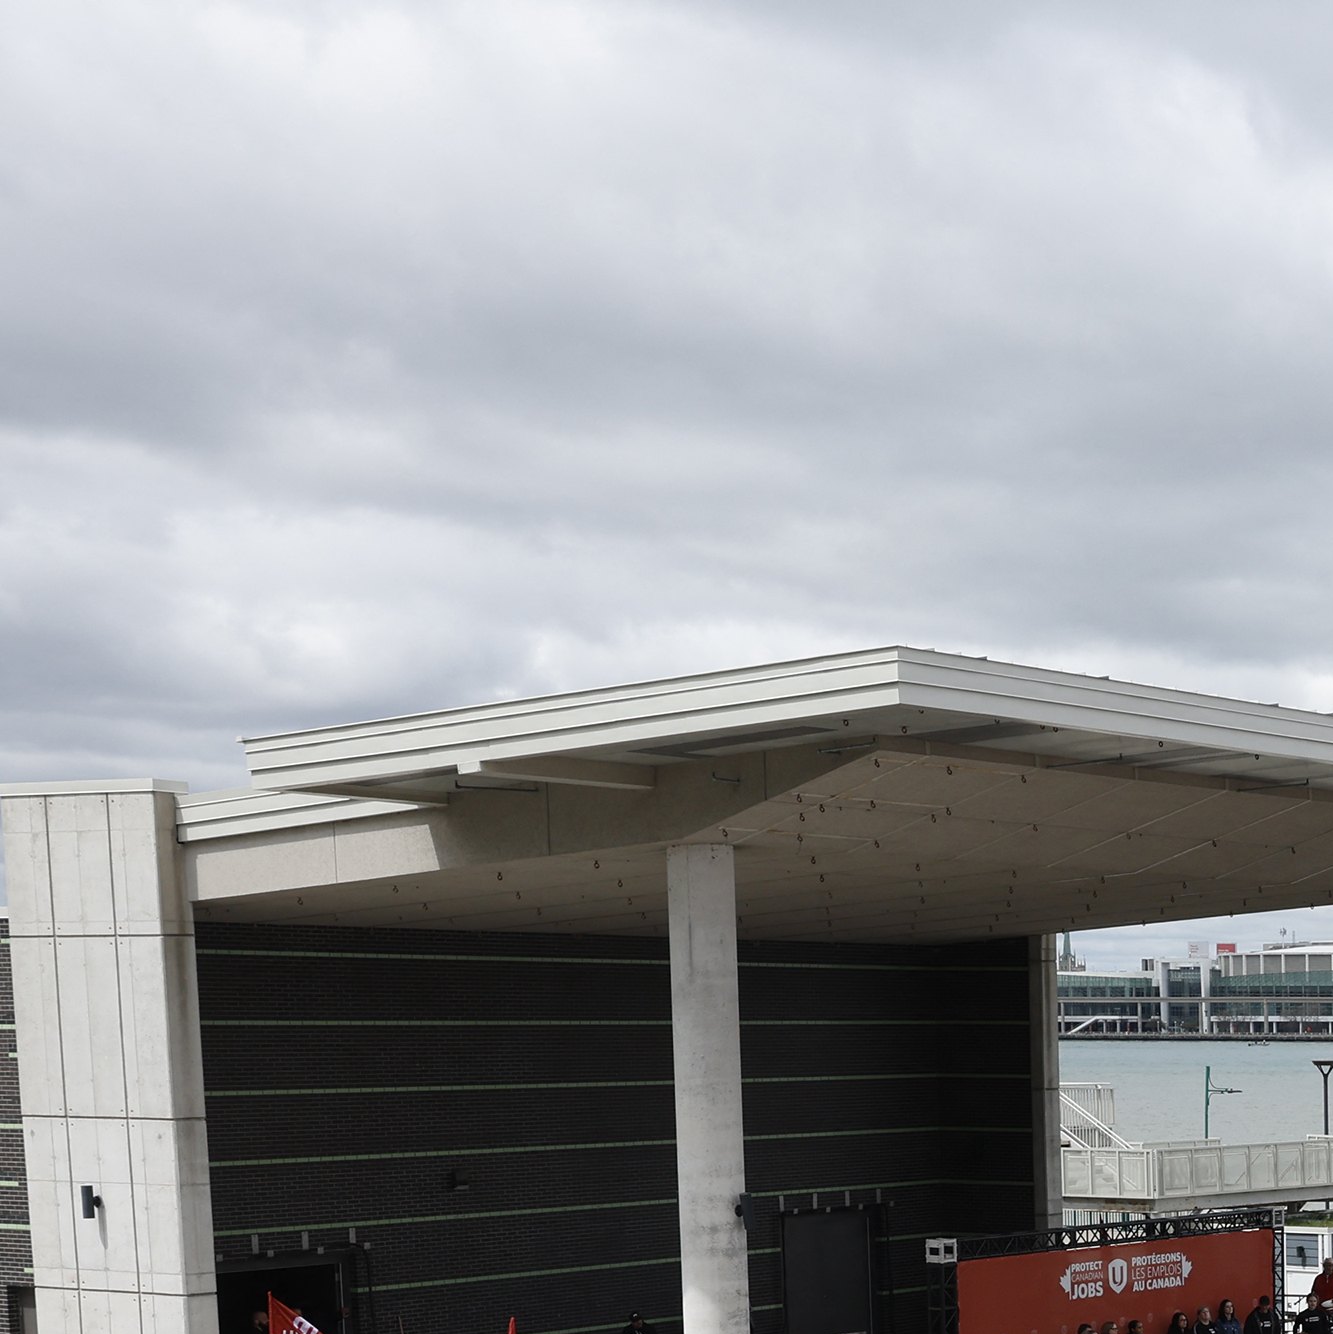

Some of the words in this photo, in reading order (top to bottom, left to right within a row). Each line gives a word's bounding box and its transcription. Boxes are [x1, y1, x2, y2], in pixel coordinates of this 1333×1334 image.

[1071, 1261, 1103, 1272] PROTECT
[1131, 1252, 1181, 1267] PROTÉGEONS
[1071, 1271, 1104, 1283] CANADIAN
[1131, 1268, 1145, 1280] LES
[1147, 1263, 1182, 1278] EMPLOIS
[1072, 1282, 1104, 1300] JOBS
[1132, 1280, 1145, 1292] AU
[1146, 1276, 1182, 1290] CANADA
